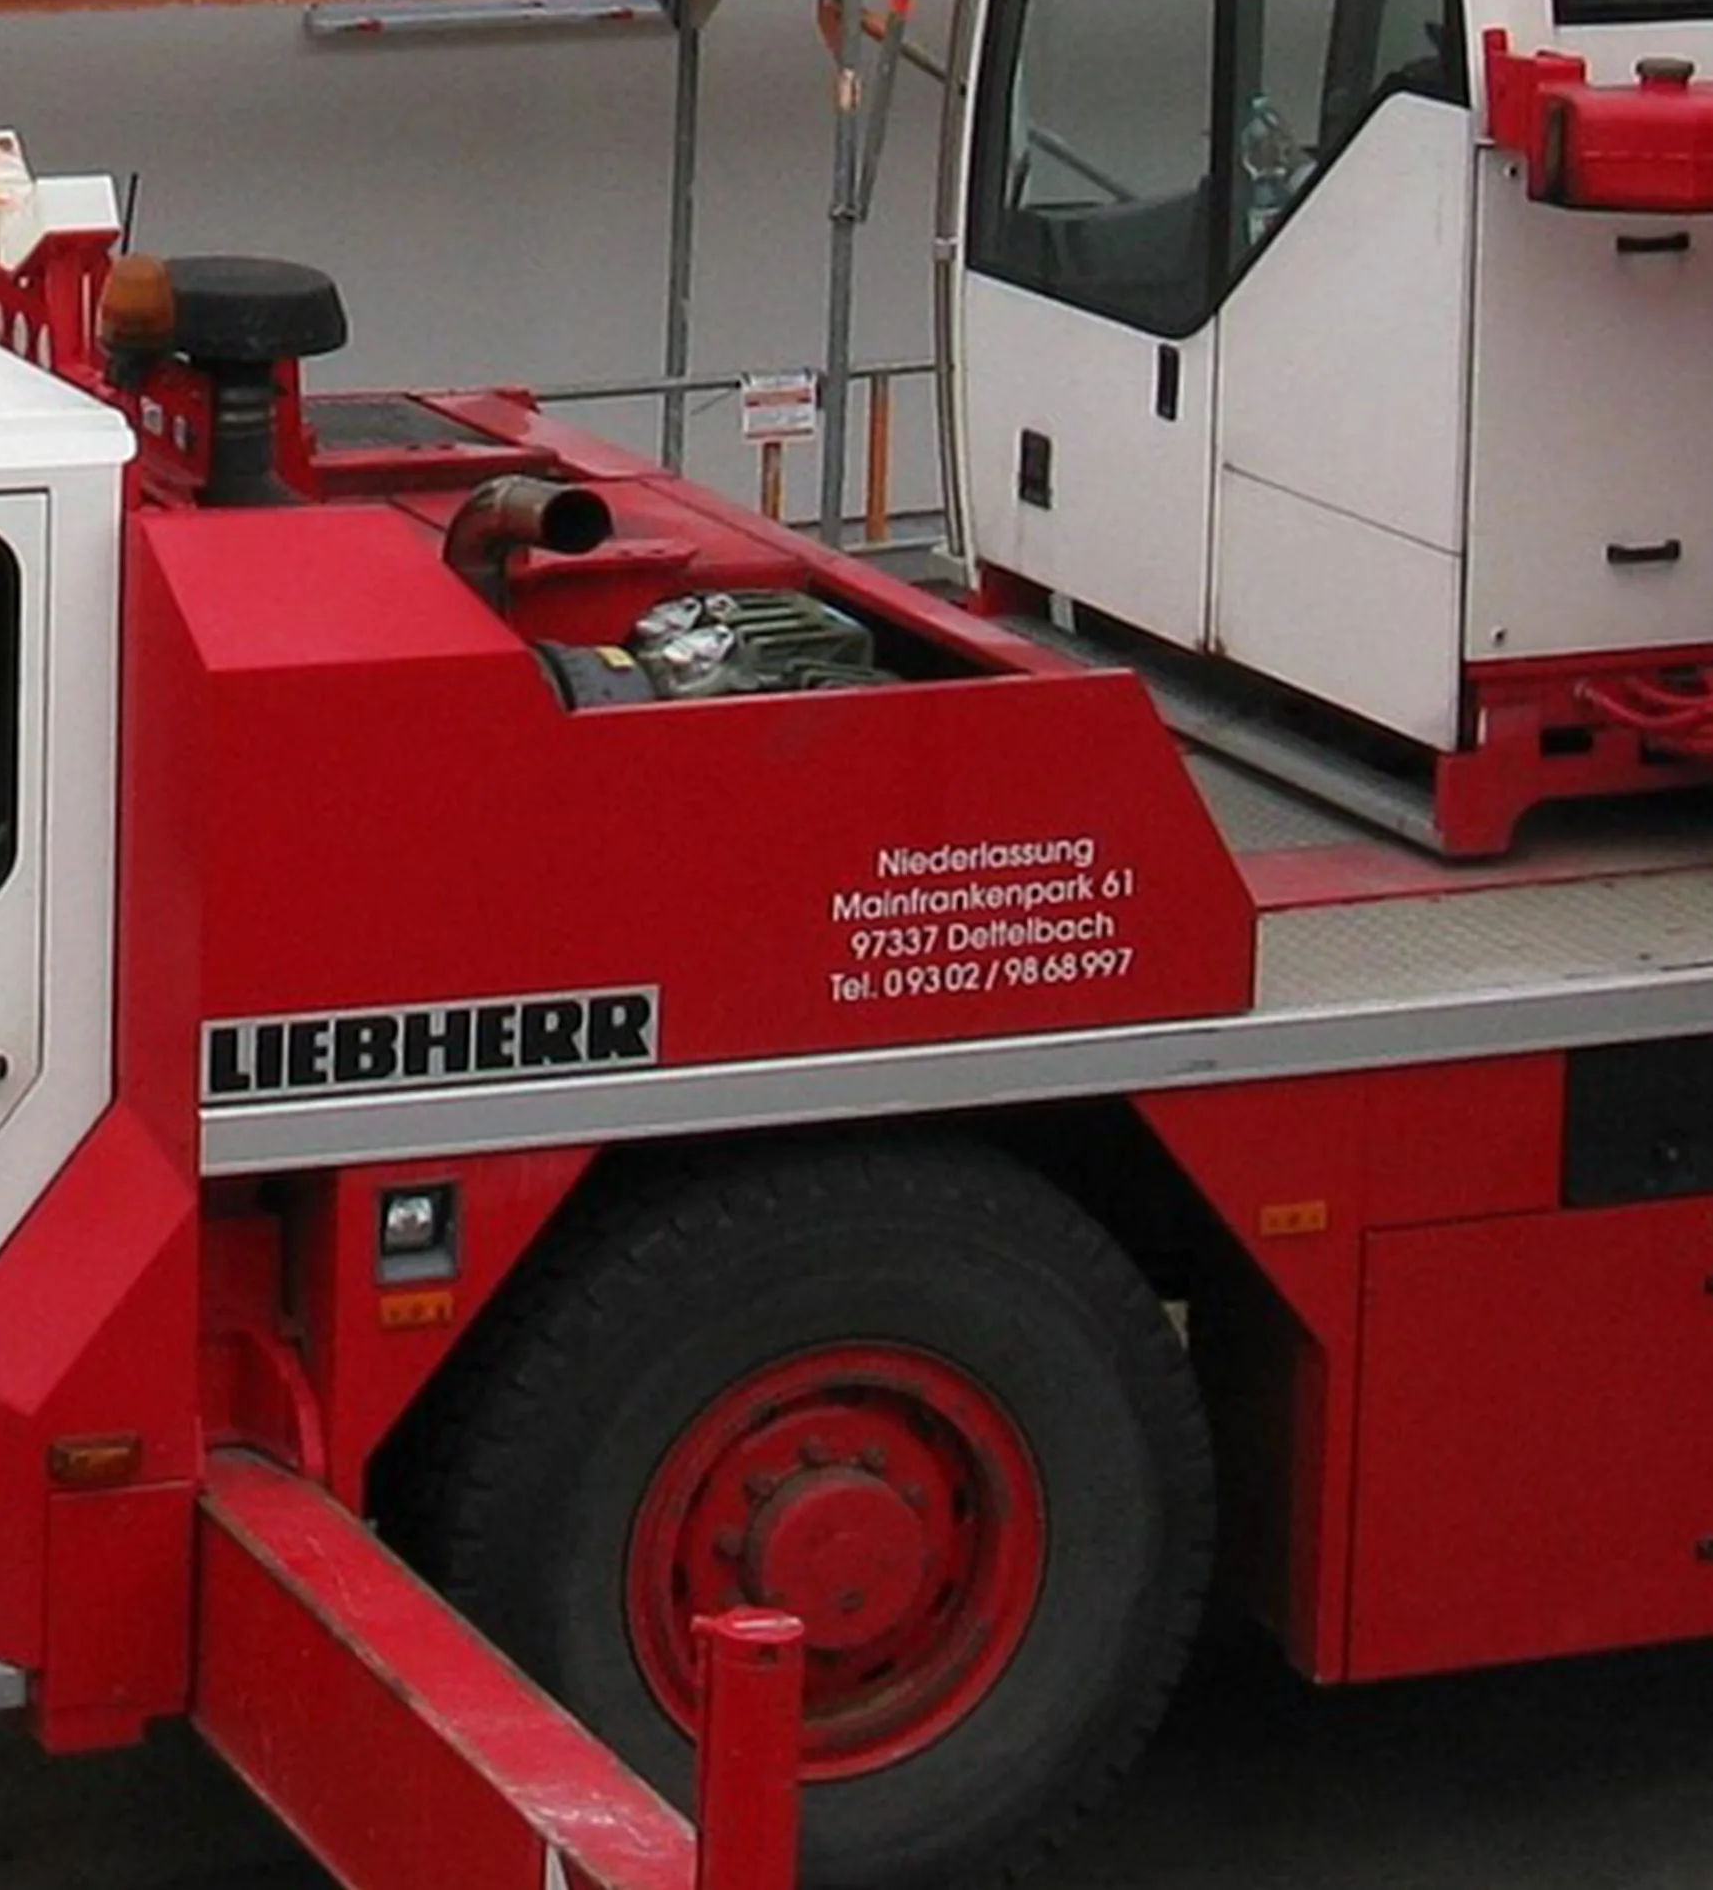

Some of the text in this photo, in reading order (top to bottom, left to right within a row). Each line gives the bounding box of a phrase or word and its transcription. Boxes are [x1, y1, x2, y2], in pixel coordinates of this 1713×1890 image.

[877, 837, 1095, 878] Niederlassung
[831, 868, 1135, 922] Mainfrankenpark 61
[849, 911, 1115, 960] 97337 Dettelbach
[829, 972, 878, 1003] Tel.
[208, 993, 652, 1095] LIEBHERR
